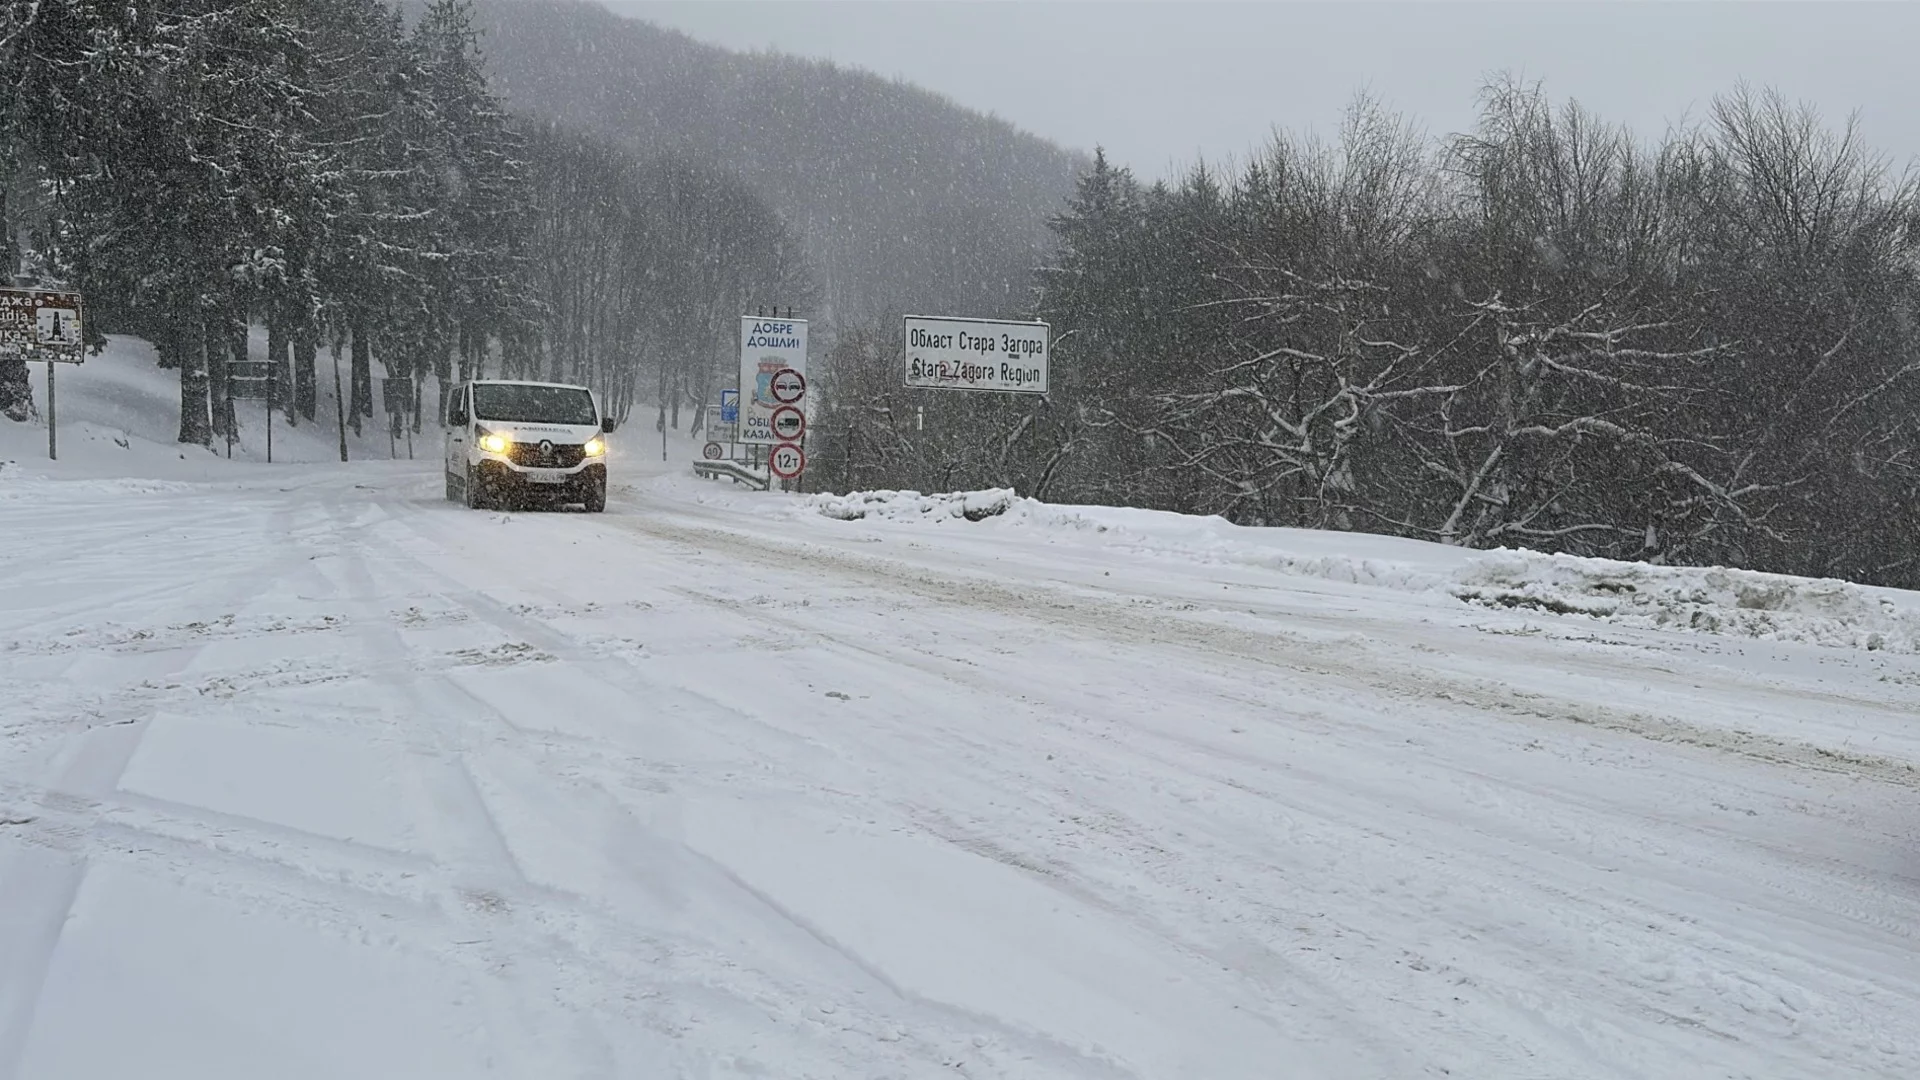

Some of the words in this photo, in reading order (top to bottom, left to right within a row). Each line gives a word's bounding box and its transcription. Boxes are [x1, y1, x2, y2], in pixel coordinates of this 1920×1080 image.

[752, 322, 793, 335] ДОБРЕ
[747, 335, 800, 349] ДОШЛИ!
[910, 328, 953, 349] Област
[959, 331, 995, 355] Стара
[1001, 333, 1043, 359] Загора
[912, 357, 947, 377] Stara
[953, 359, 995, 384] Zagora
[1001, 362, 1040, 386] Region
